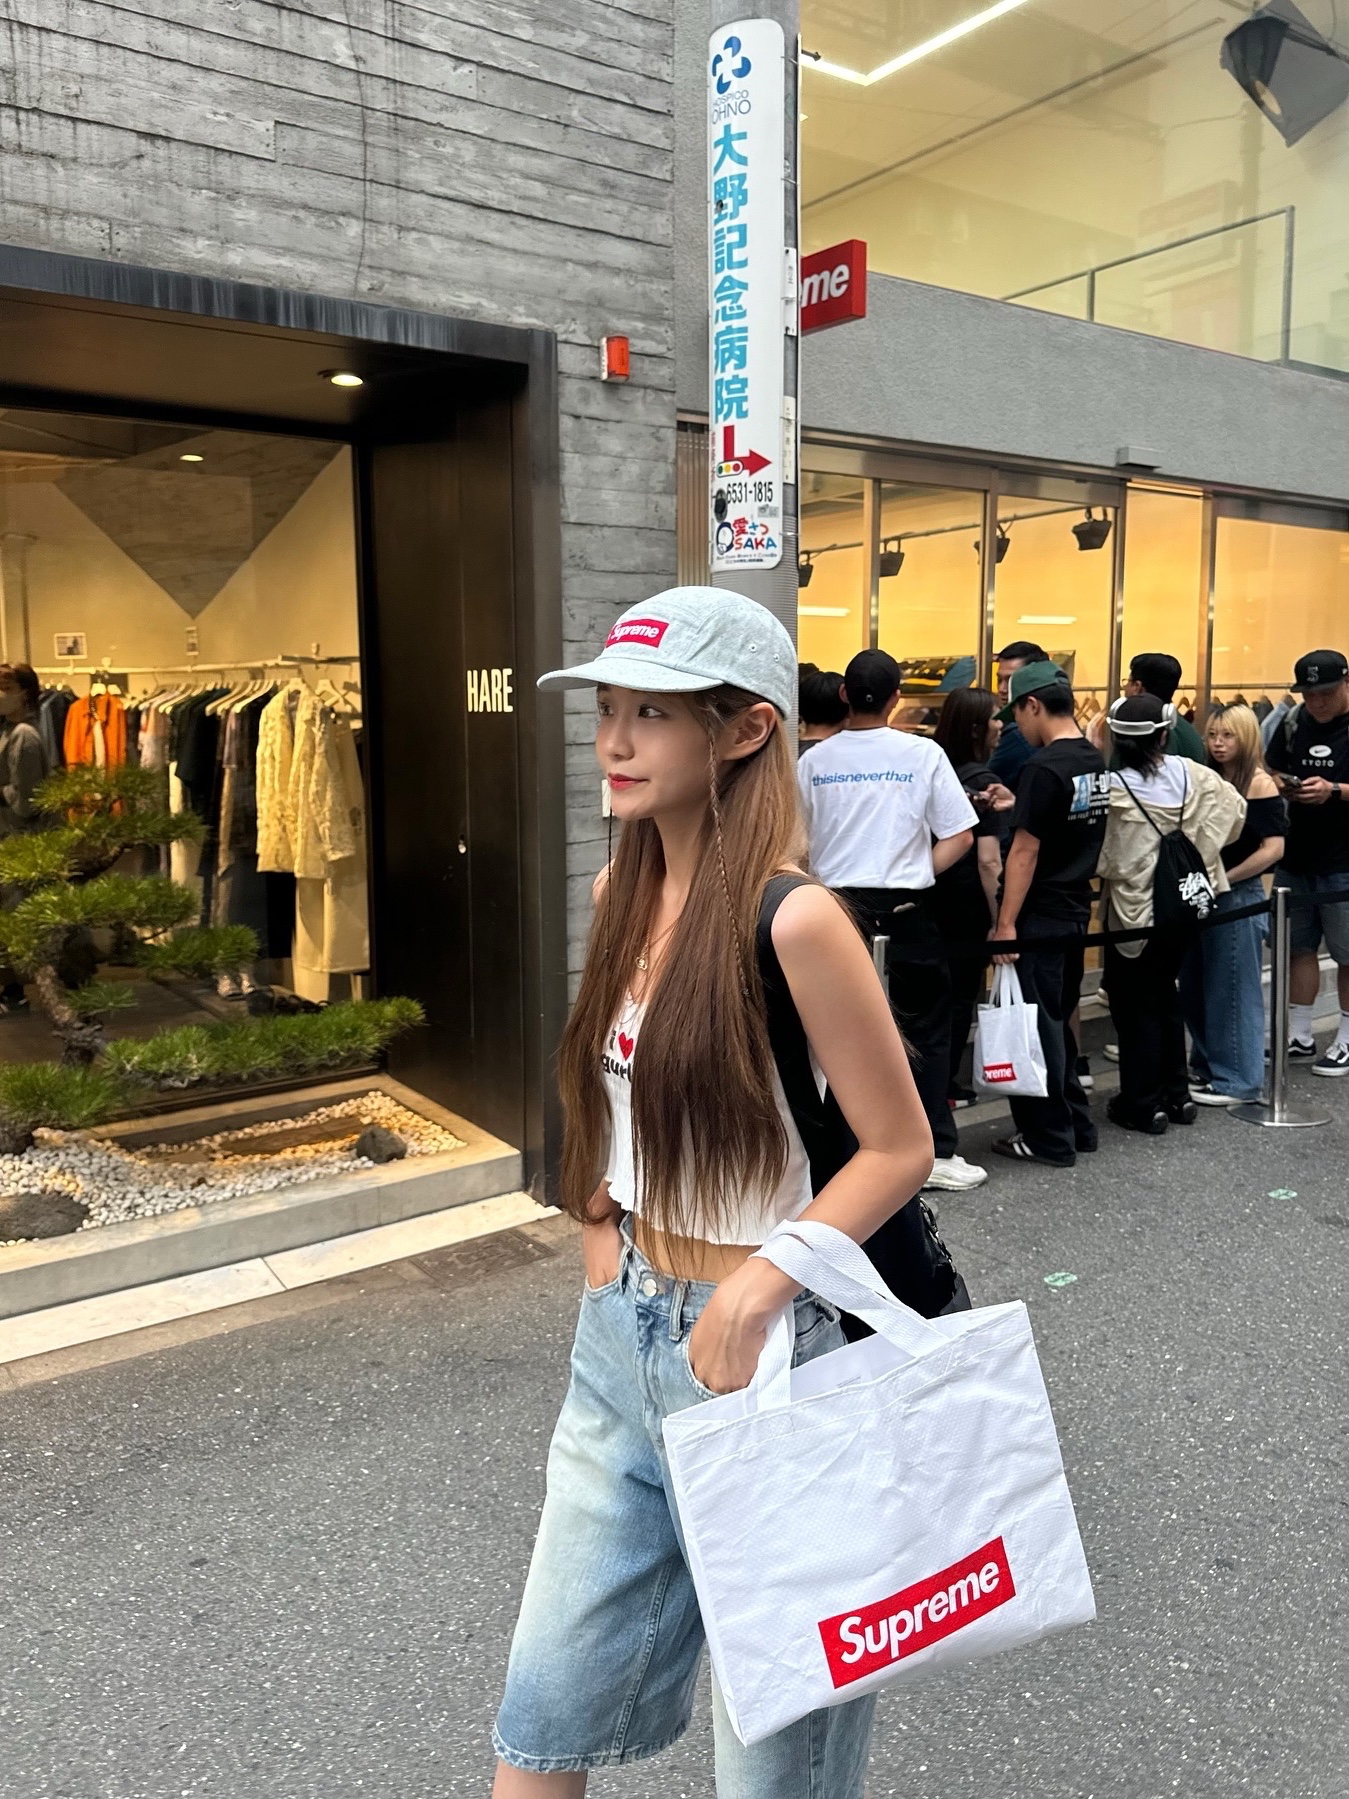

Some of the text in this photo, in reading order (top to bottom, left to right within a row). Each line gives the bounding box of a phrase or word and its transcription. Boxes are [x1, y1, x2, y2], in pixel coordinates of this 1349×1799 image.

[711, 99, 752, 125] OHNO
[713, 123, 749, 424] 大野記念病院
[799, 264, 850, 309] me
[466, 667, 514, 713] HARE
[812, 770, 914, 787] thisisneverthat
[1301, 758, 1335, 768] KYOTO
[839, 1561, 1000, 1664] Supreme
